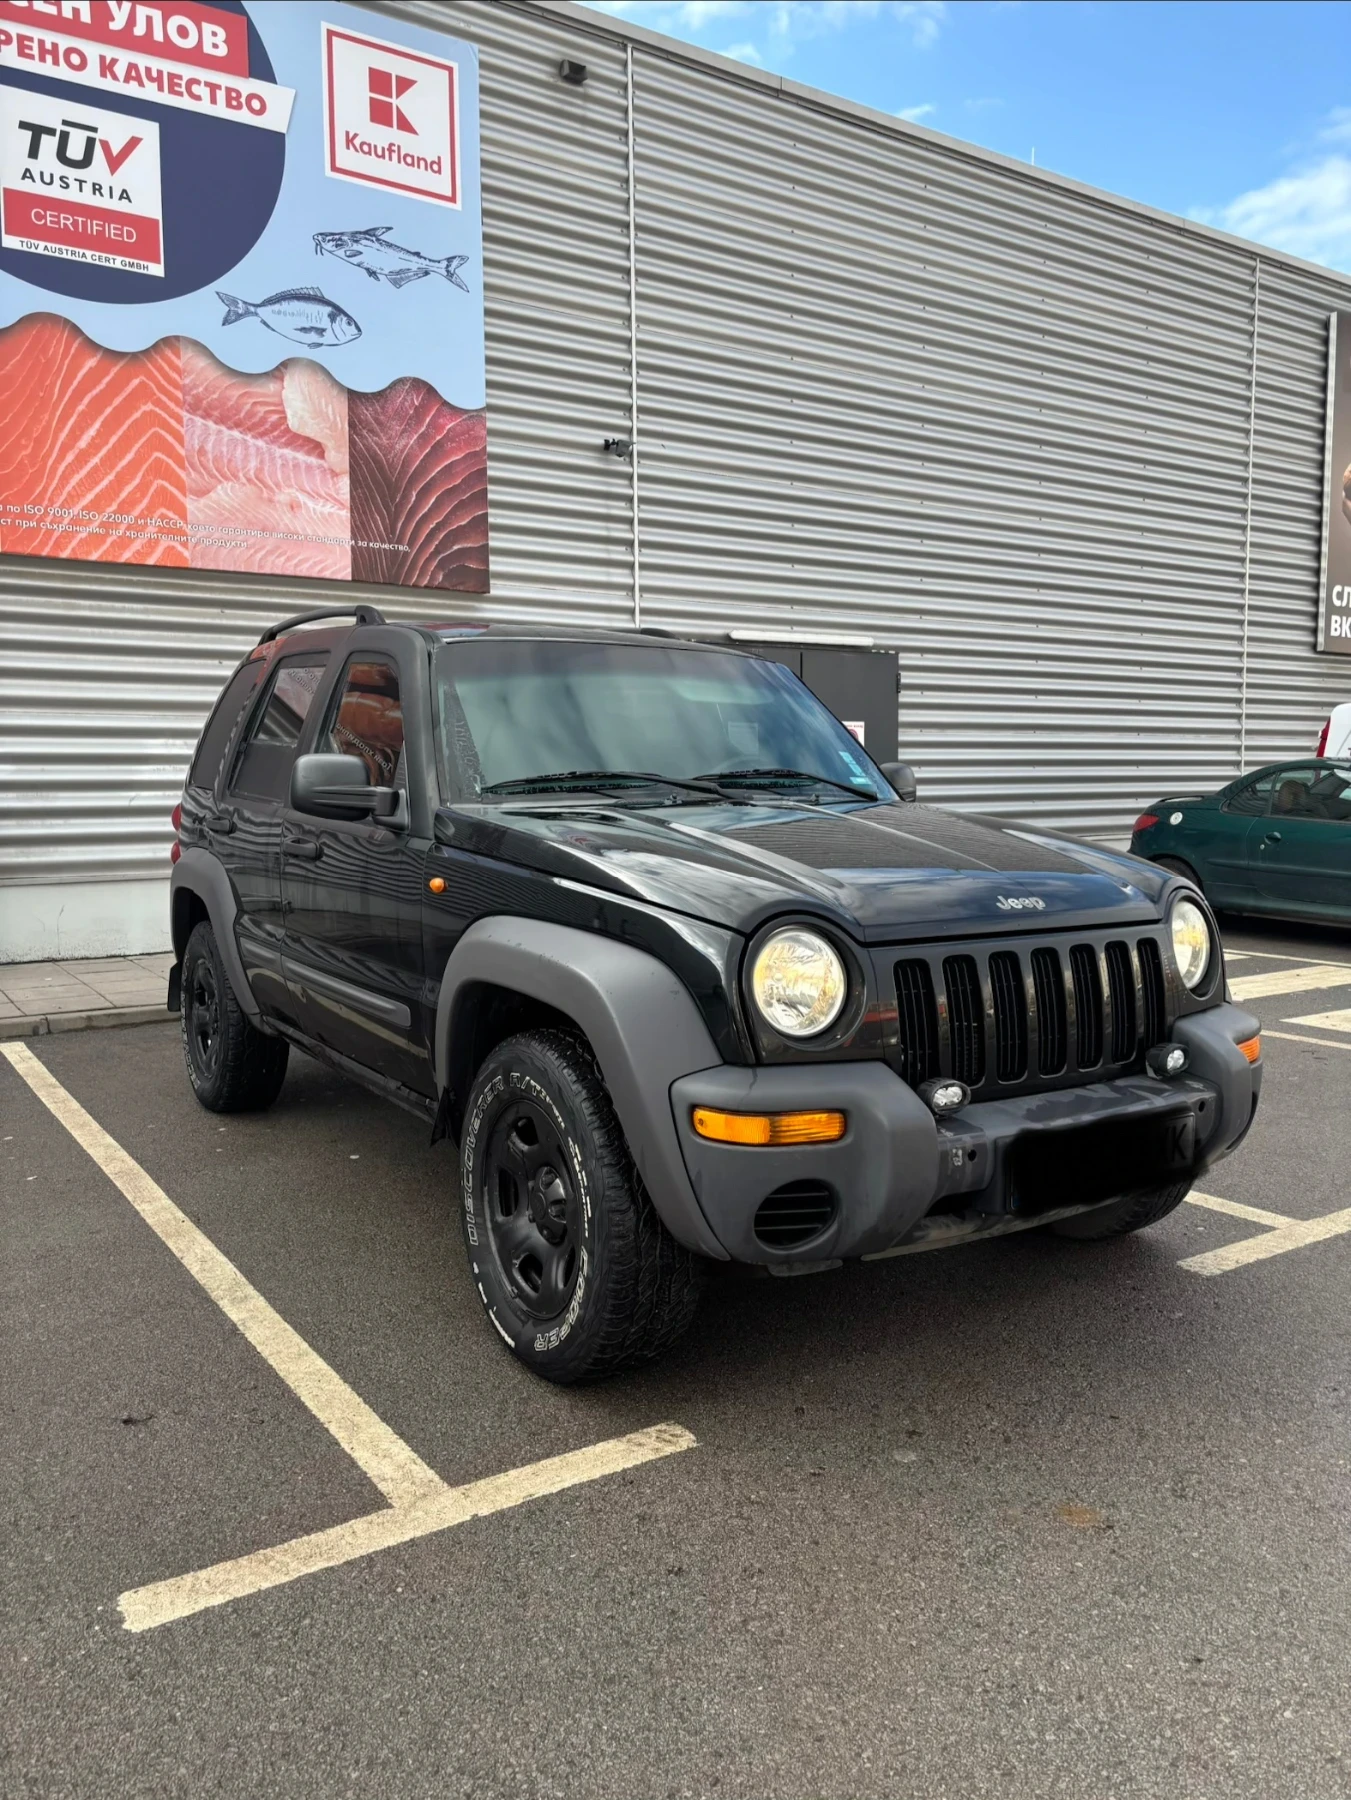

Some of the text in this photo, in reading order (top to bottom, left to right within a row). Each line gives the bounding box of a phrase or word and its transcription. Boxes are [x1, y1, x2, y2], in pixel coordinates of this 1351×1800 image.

[107, 0, 228, 57] УЛОВ
[98, 53, 267, 116] КАЧЕСТВО
[345, 130, 442, 175] Kaufland
[21, 167, 132, 203] AUSTRIA
[31, 208, 137, 243] CERTIFIED
[19, 240, 149, 272] TÜV AUSTRIA CERT GMBH
[7, 504, 21, 513] по
[24, 504, 44, 515] ISO
[47, 507, 76, 520] 9001,
[79, 510, 99, 521] ISO
[102, 513, 135, 525] 22000
[188, 523, 216, 533] което
[219, 527, 269, 538] гарантира
[16, 519, 37, 529] при
[40, 521, 106, 535] съхранение
[126, 530, 197, 544] хранителните
[995, 895, 1046, 911] Jeep
[534, 1245, 588, 1351] COOPER
